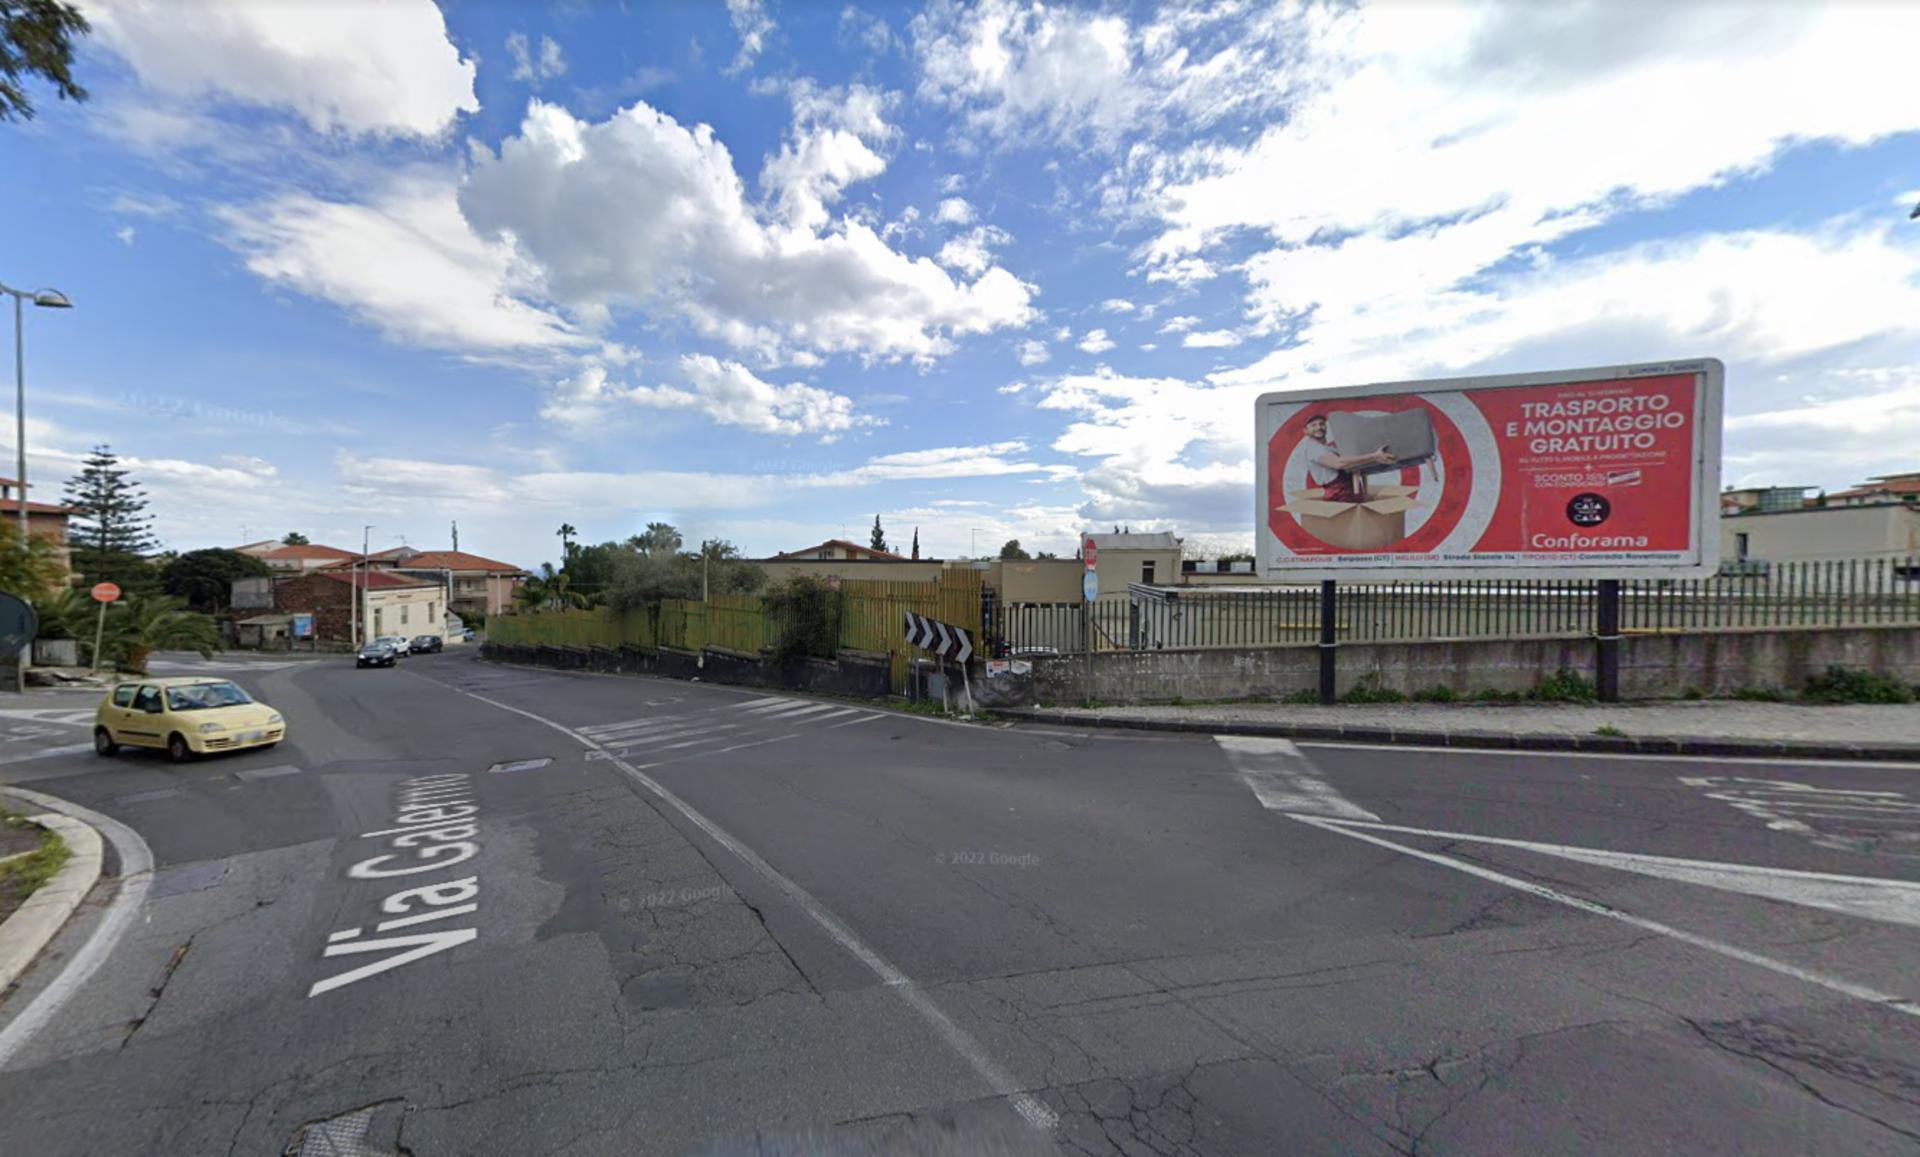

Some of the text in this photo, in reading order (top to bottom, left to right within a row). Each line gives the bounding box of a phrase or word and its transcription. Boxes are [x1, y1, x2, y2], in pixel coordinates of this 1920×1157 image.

[1521, 395, 1669, 418] TRASPORTO
[1506, 412, 1685, 437] E MONTAGGIO
[1530, 432, 1655, 454] GRATUITO
[1535, 473, 1583, 482] SCONTO
[1532, 533, 1648, 549] Conforama
[308, 773, 480, 998] Via Galermo
